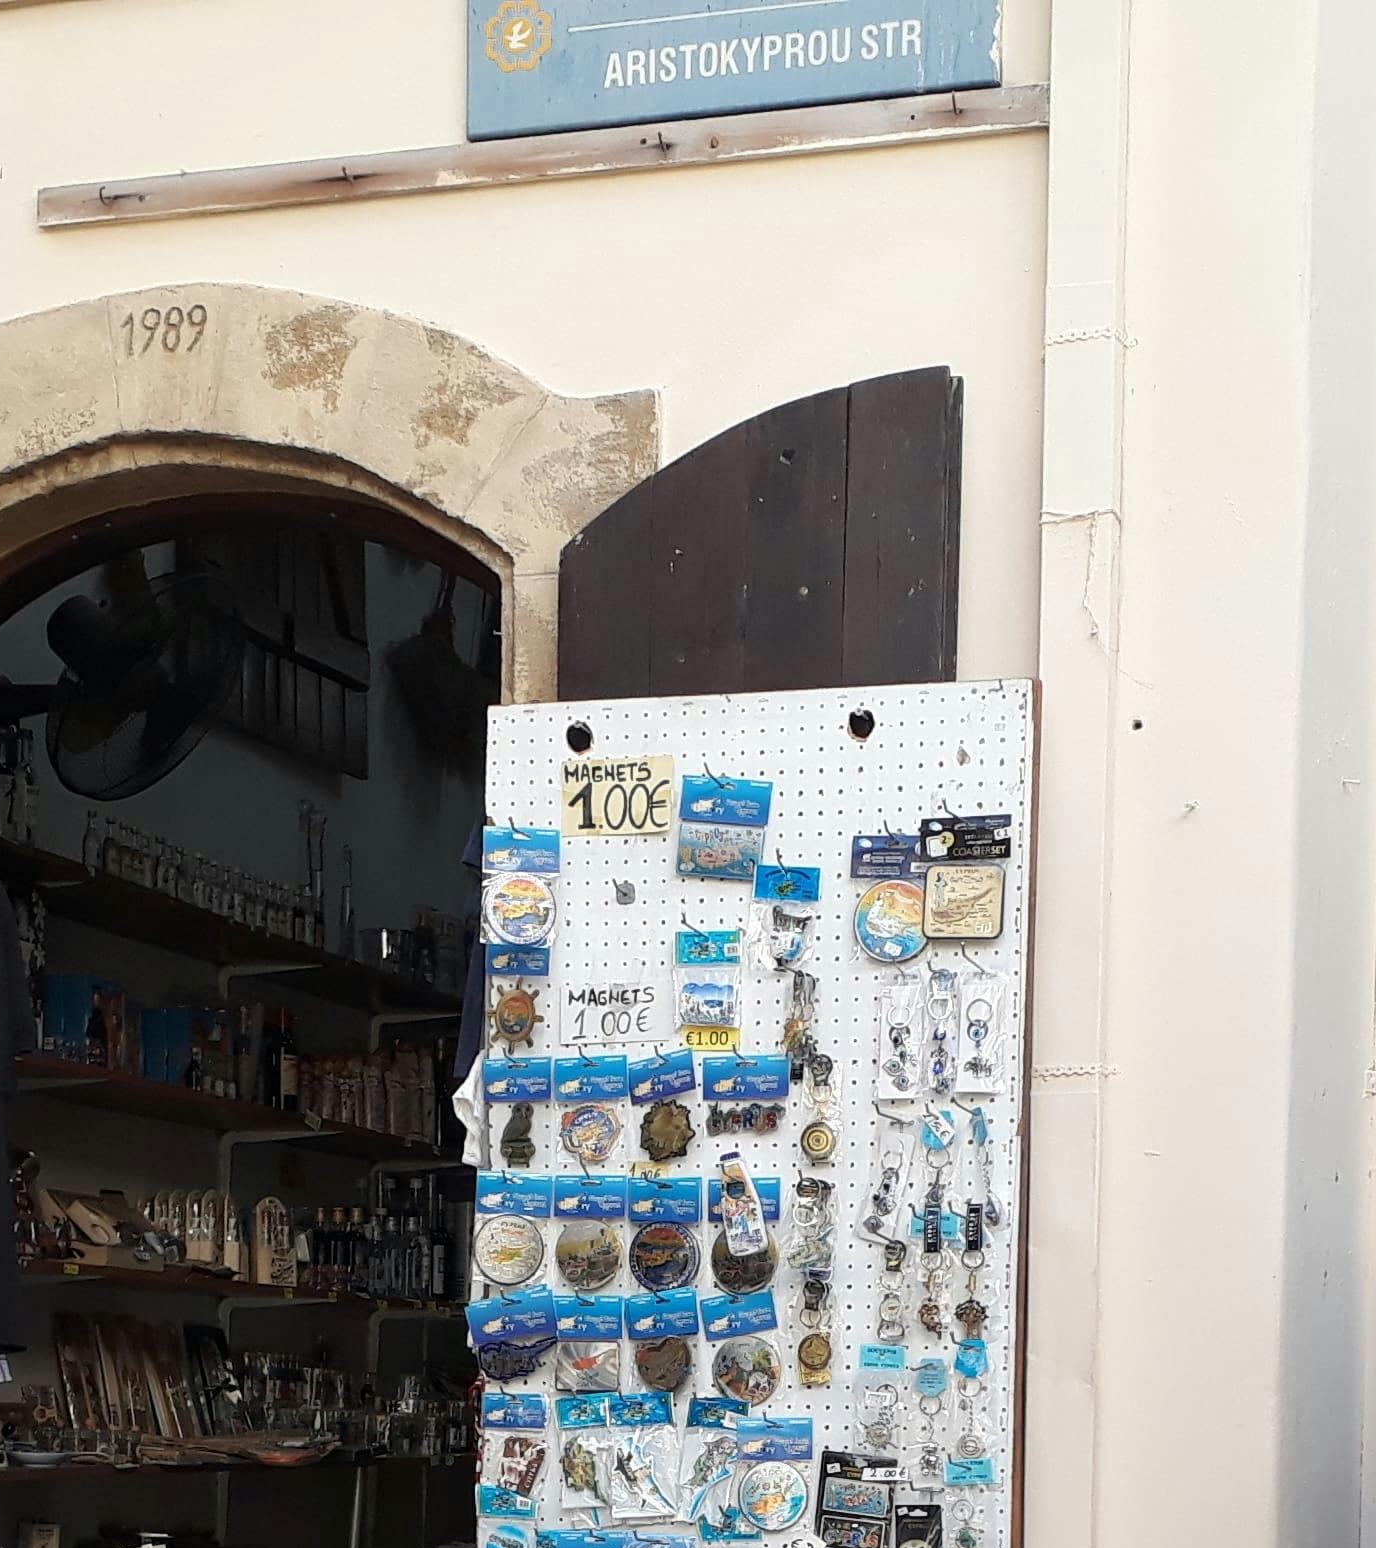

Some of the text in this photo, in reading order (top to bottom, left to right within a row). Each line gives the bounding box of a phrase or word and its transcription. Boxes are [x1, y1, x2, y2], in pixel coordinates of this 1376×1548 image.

[603, 18, 922, 89] ARISTOKYPROU STR
[120, 303, 208, 357] 1989
[564, 762, 652, 784] MAGNETS
[568, 780, 670, 830] 1.00€
[568, 986, 655, 1007] MAGNETS
[685, 1030, 729, 1047] €1.00
